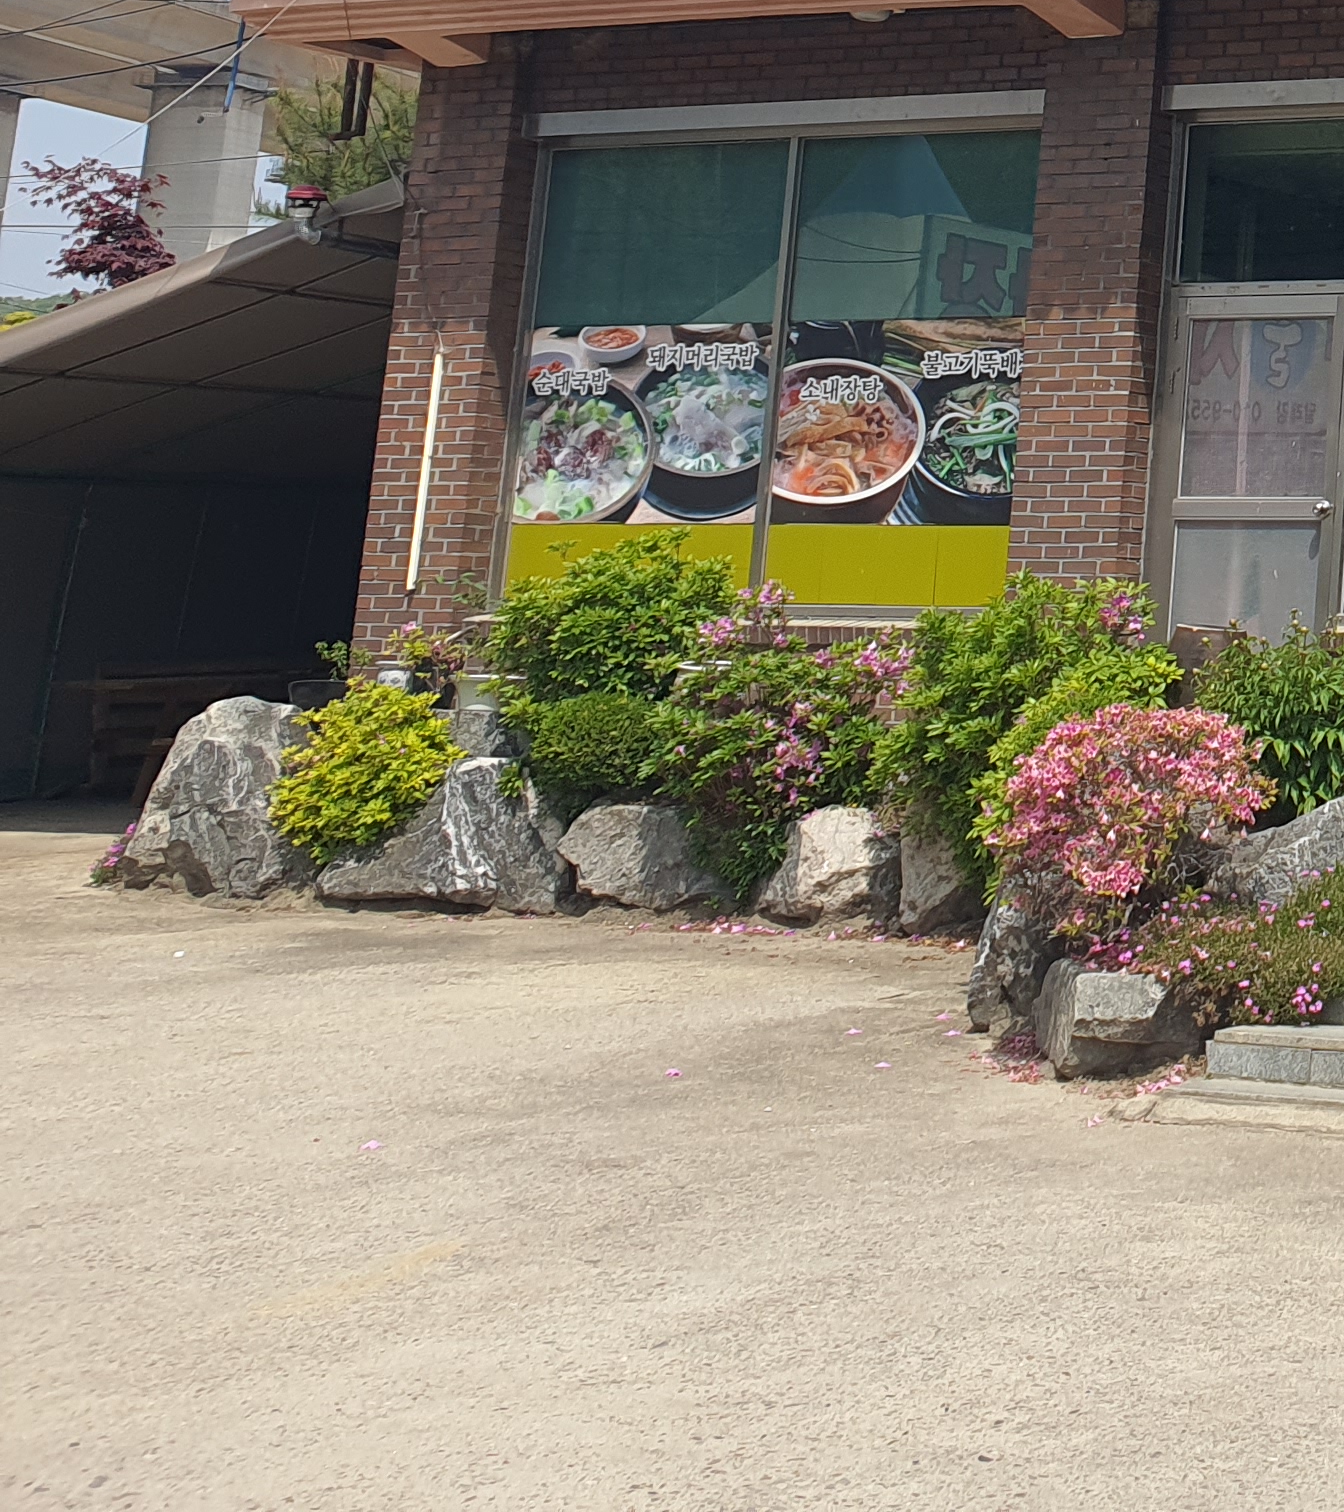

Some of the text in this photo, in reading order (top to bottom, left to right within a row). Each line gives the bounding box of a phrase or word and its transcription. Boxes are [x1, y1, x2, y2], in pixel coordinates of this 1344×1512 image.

[648, 343, 759, 370] 돼지머리국밥
[920, 349, 1024, 379] 불고기뚝배
[533, 367, 611, 396] 순대국밥
[800, 375, 883, 403] 소내장탕
